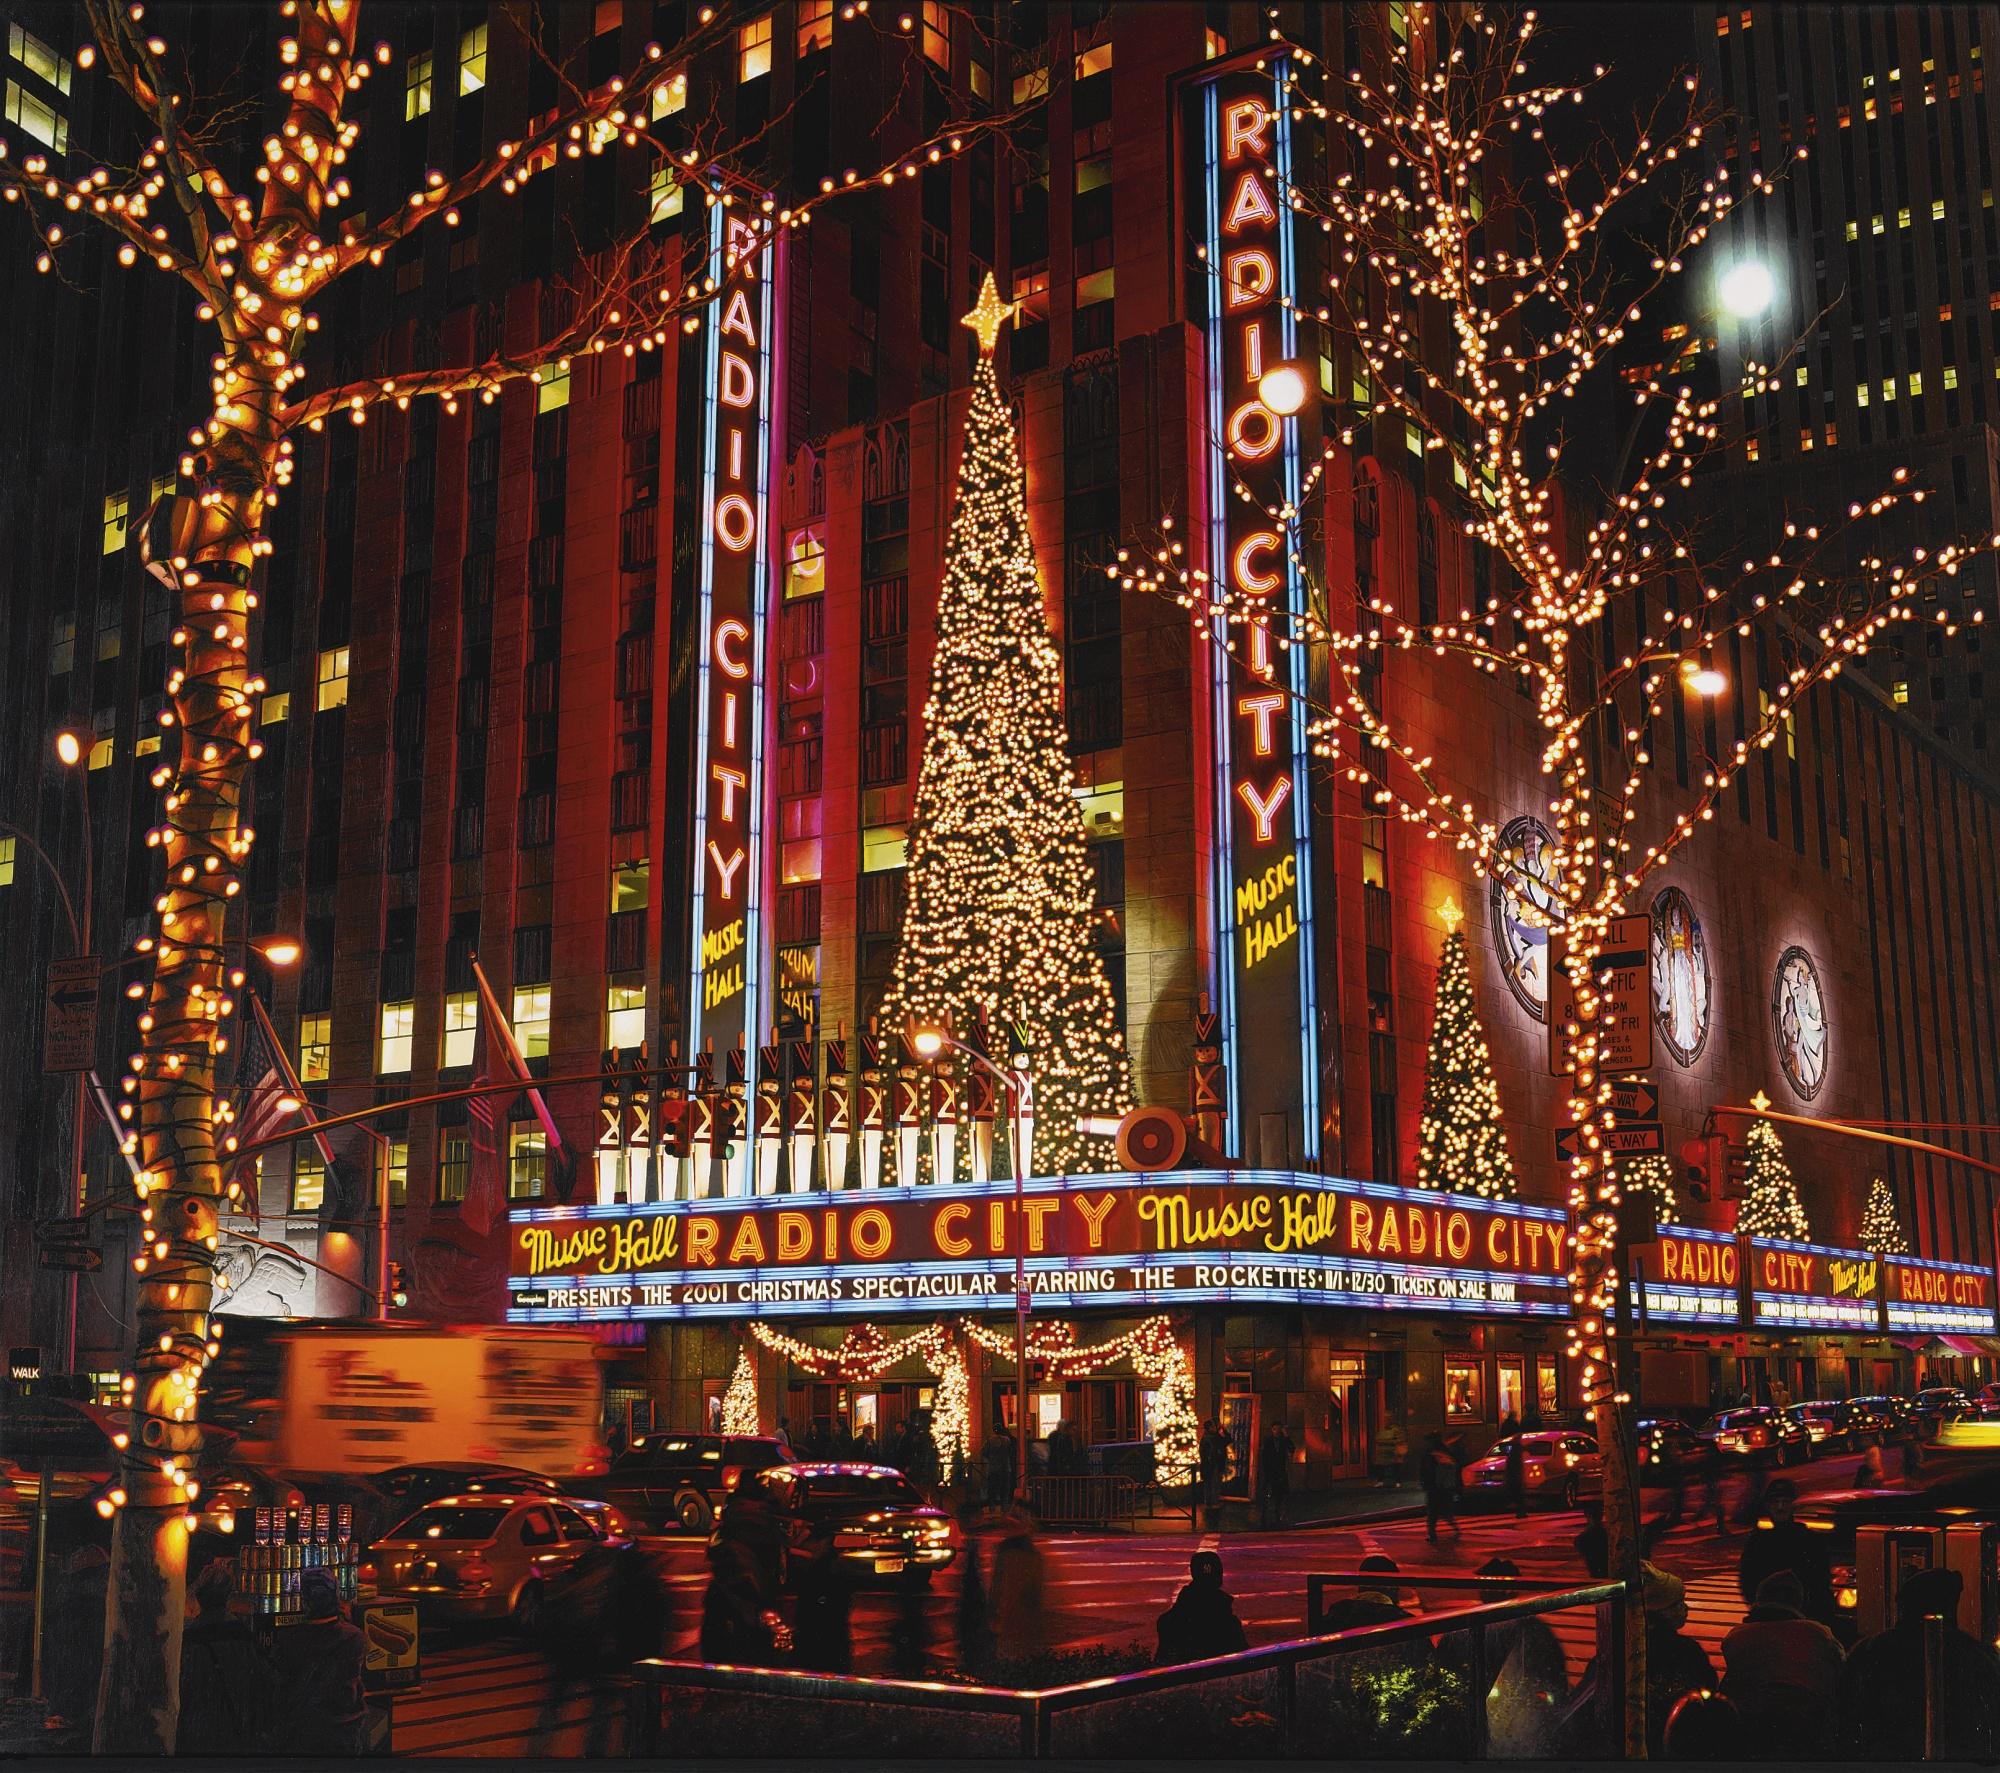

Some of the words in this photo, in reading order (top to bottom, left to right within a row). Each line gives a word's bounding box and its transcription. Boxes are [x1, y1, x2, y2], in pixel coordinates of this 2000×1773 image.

[1225, 100, 1282, 459] RADIO
[714, 216, 759, 552] RADIO
[1233, 532, 1291, 841] CITY
[707, 619, 748, 899] CITY
[1237, 854, 1296, 926] MUSIC
[701, 918, 745, 970] MUSIC
[1245, 903, 1298, 968] HALL
[705, 966, 745, 1010] HALL
[1600, 972, 1636, 993] AFFIC
[1622, 1017, 1639, 1030] FRI
[1617, 1093, 1637, 1108] WAY
[1602, 1134, 1616, 1149] NE
[1620, 1133, 1647, 1148] WAY
[519, 1225, 606, 1275] Music
[599, 1214, 679, 1274] Hall
[687, 1208, 892, 1266] RADIO
[934, 1193, 1116, 1256] CITY
[1138, 1195, 1272, 1249] Music
[1264, 1191, 1336, 1252] Hall
[1350, 1200, 1471, 1260] RADIO
[1488, 1218, 1566, 1270] CITY
[548, 1286, 632, 1308] PRESENTS
[640, 1285, 672, 1306] THE
[682, 1283, 728, 1304] 2001
[738, 1278, 842, 1302] CHRISTMAS
[852, 1273, 998, 1299] SPECTACULAR
[1130, 1267, 1175, 1289] THE
[1195, 1265, 1317, 1288] ROCKETTES
[1391, 1275, 1436, 1296] TICKETS
[1439, 1279, 1457, 1298] ON
[1459, 1280, 1486, 1299] SALE
[1491, 1282, 1516, 1301] NOW
[1662, 1239, 1736, 1285] RADIO
[1765, 1252, 1812, 1291] CITY
[1829, 1261, 1857, 1296] Music
[1855, 1261, 1877, 1298] Hall
[1901, 1268, 1947, 1303] RADIO
[1953, 1273, 1984, 1306] CITY
[11, 1366, 40, 1379] WALK
